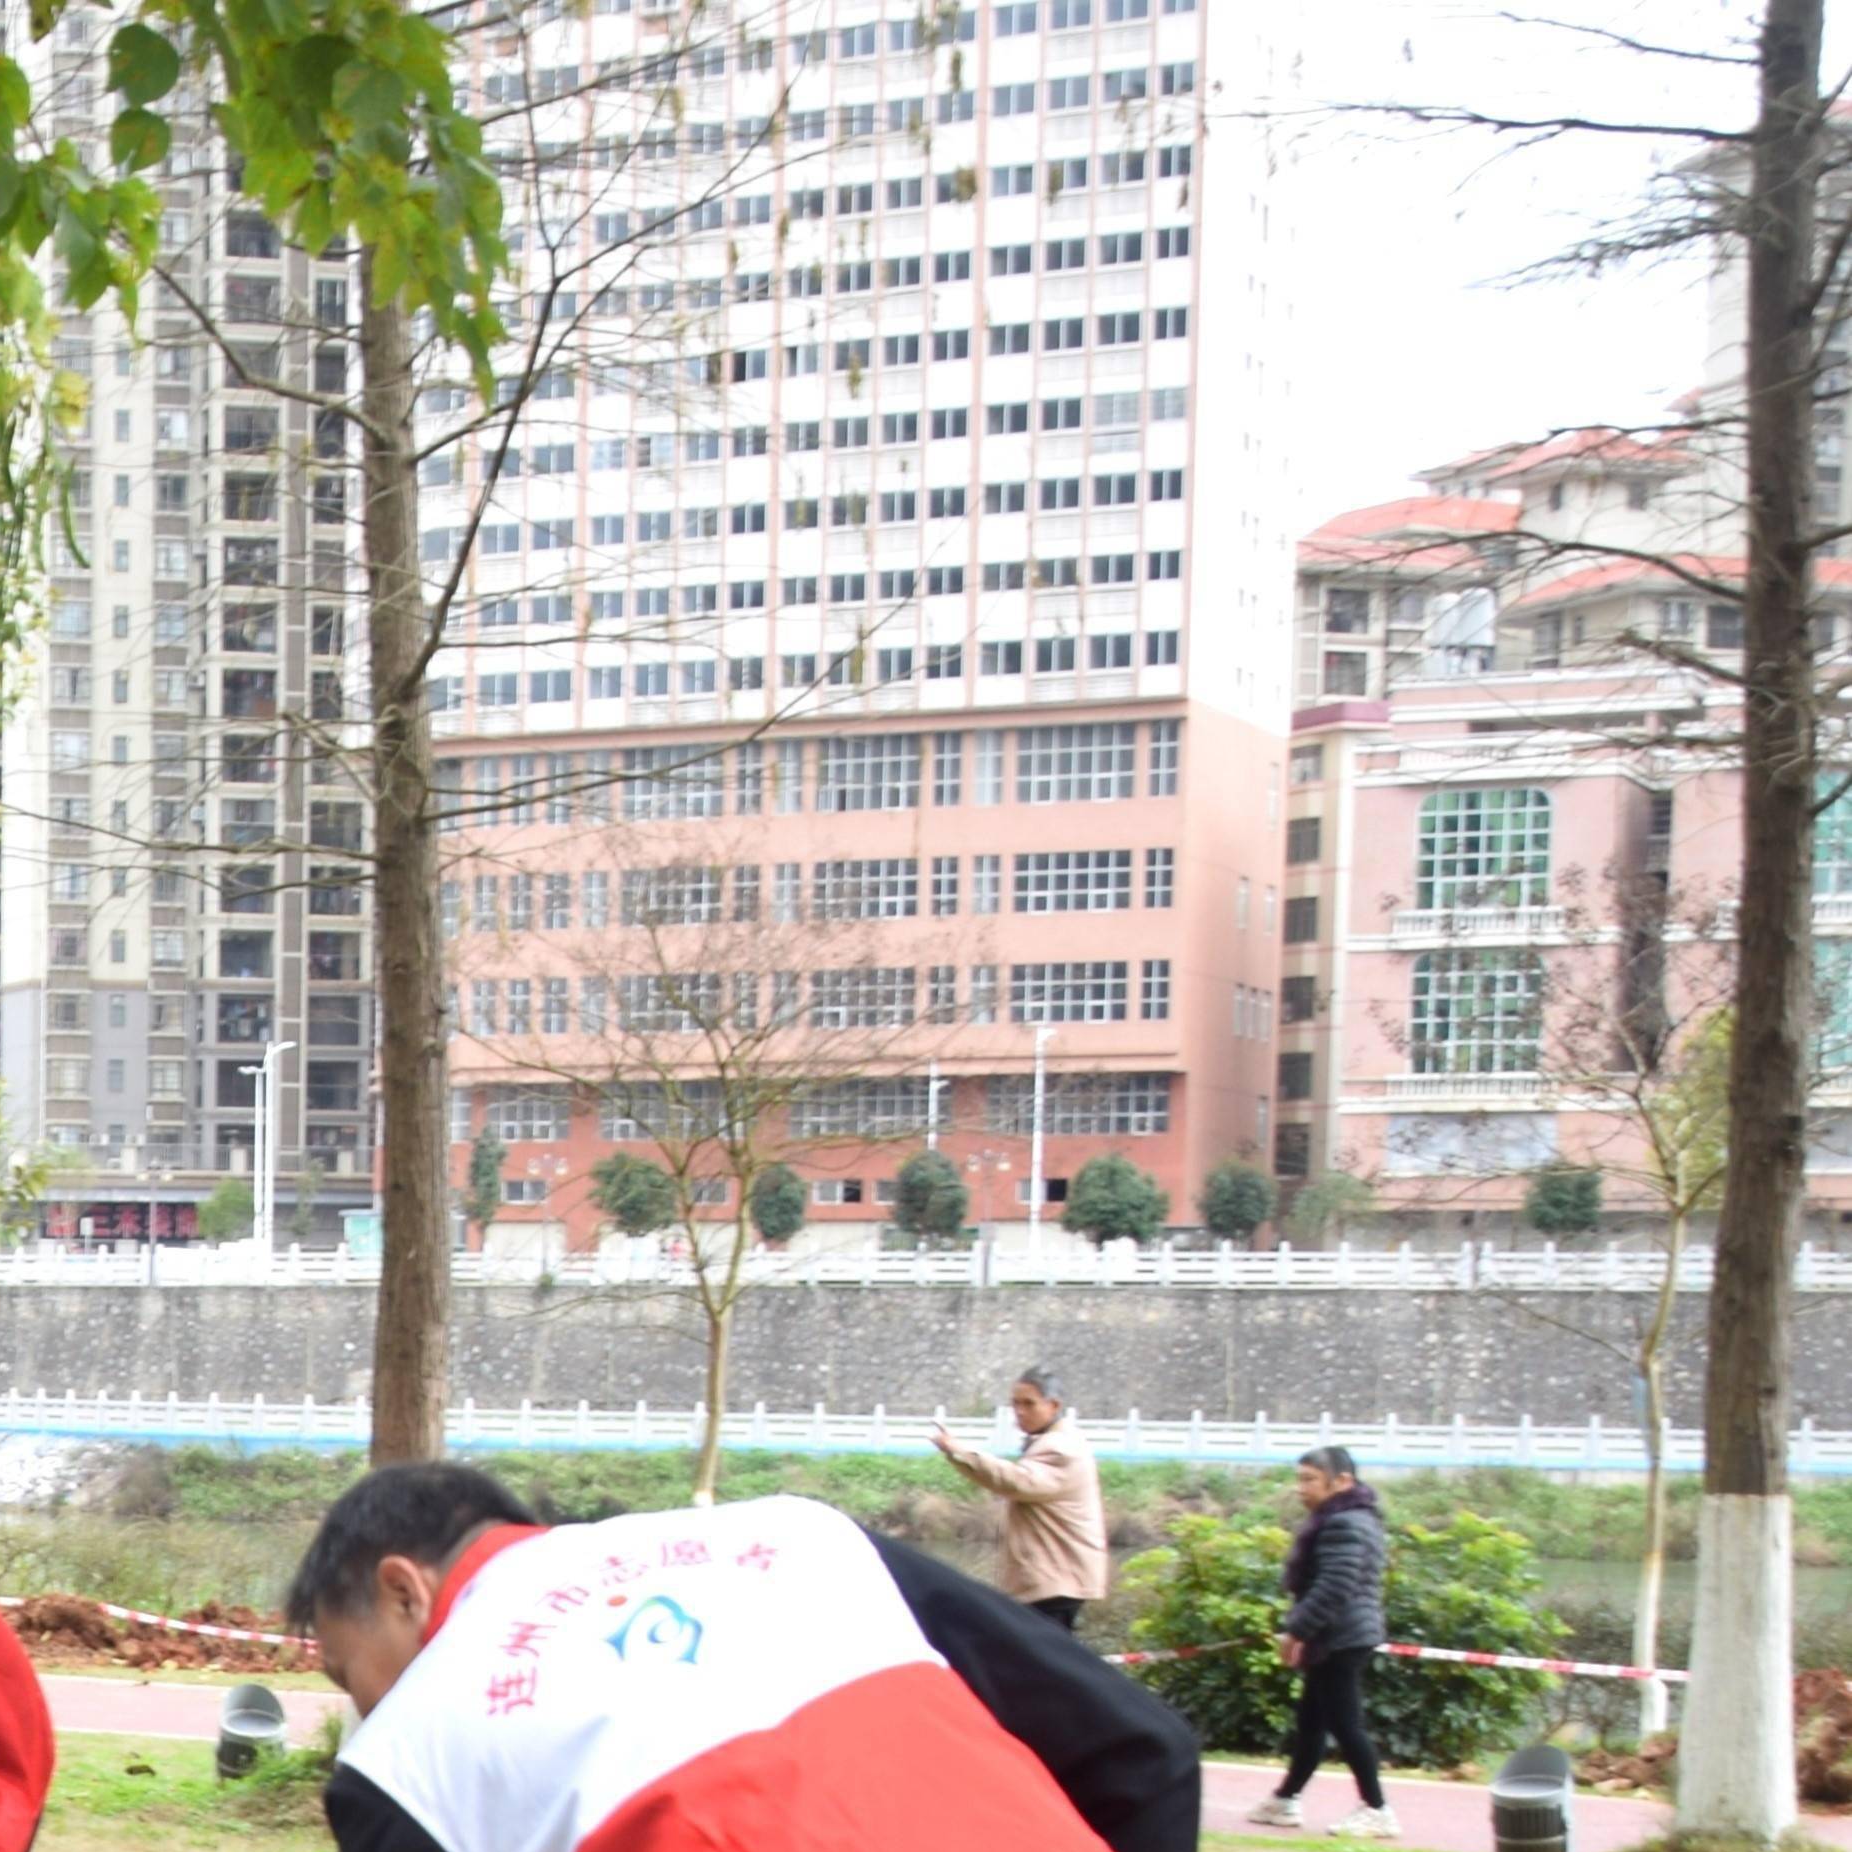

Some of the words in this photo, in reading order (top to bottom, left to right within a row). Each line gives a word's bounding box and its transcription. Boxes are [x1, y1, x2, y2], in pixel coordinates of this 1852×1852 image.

[485, 1538, 779, 1716] 连州市志愿者
